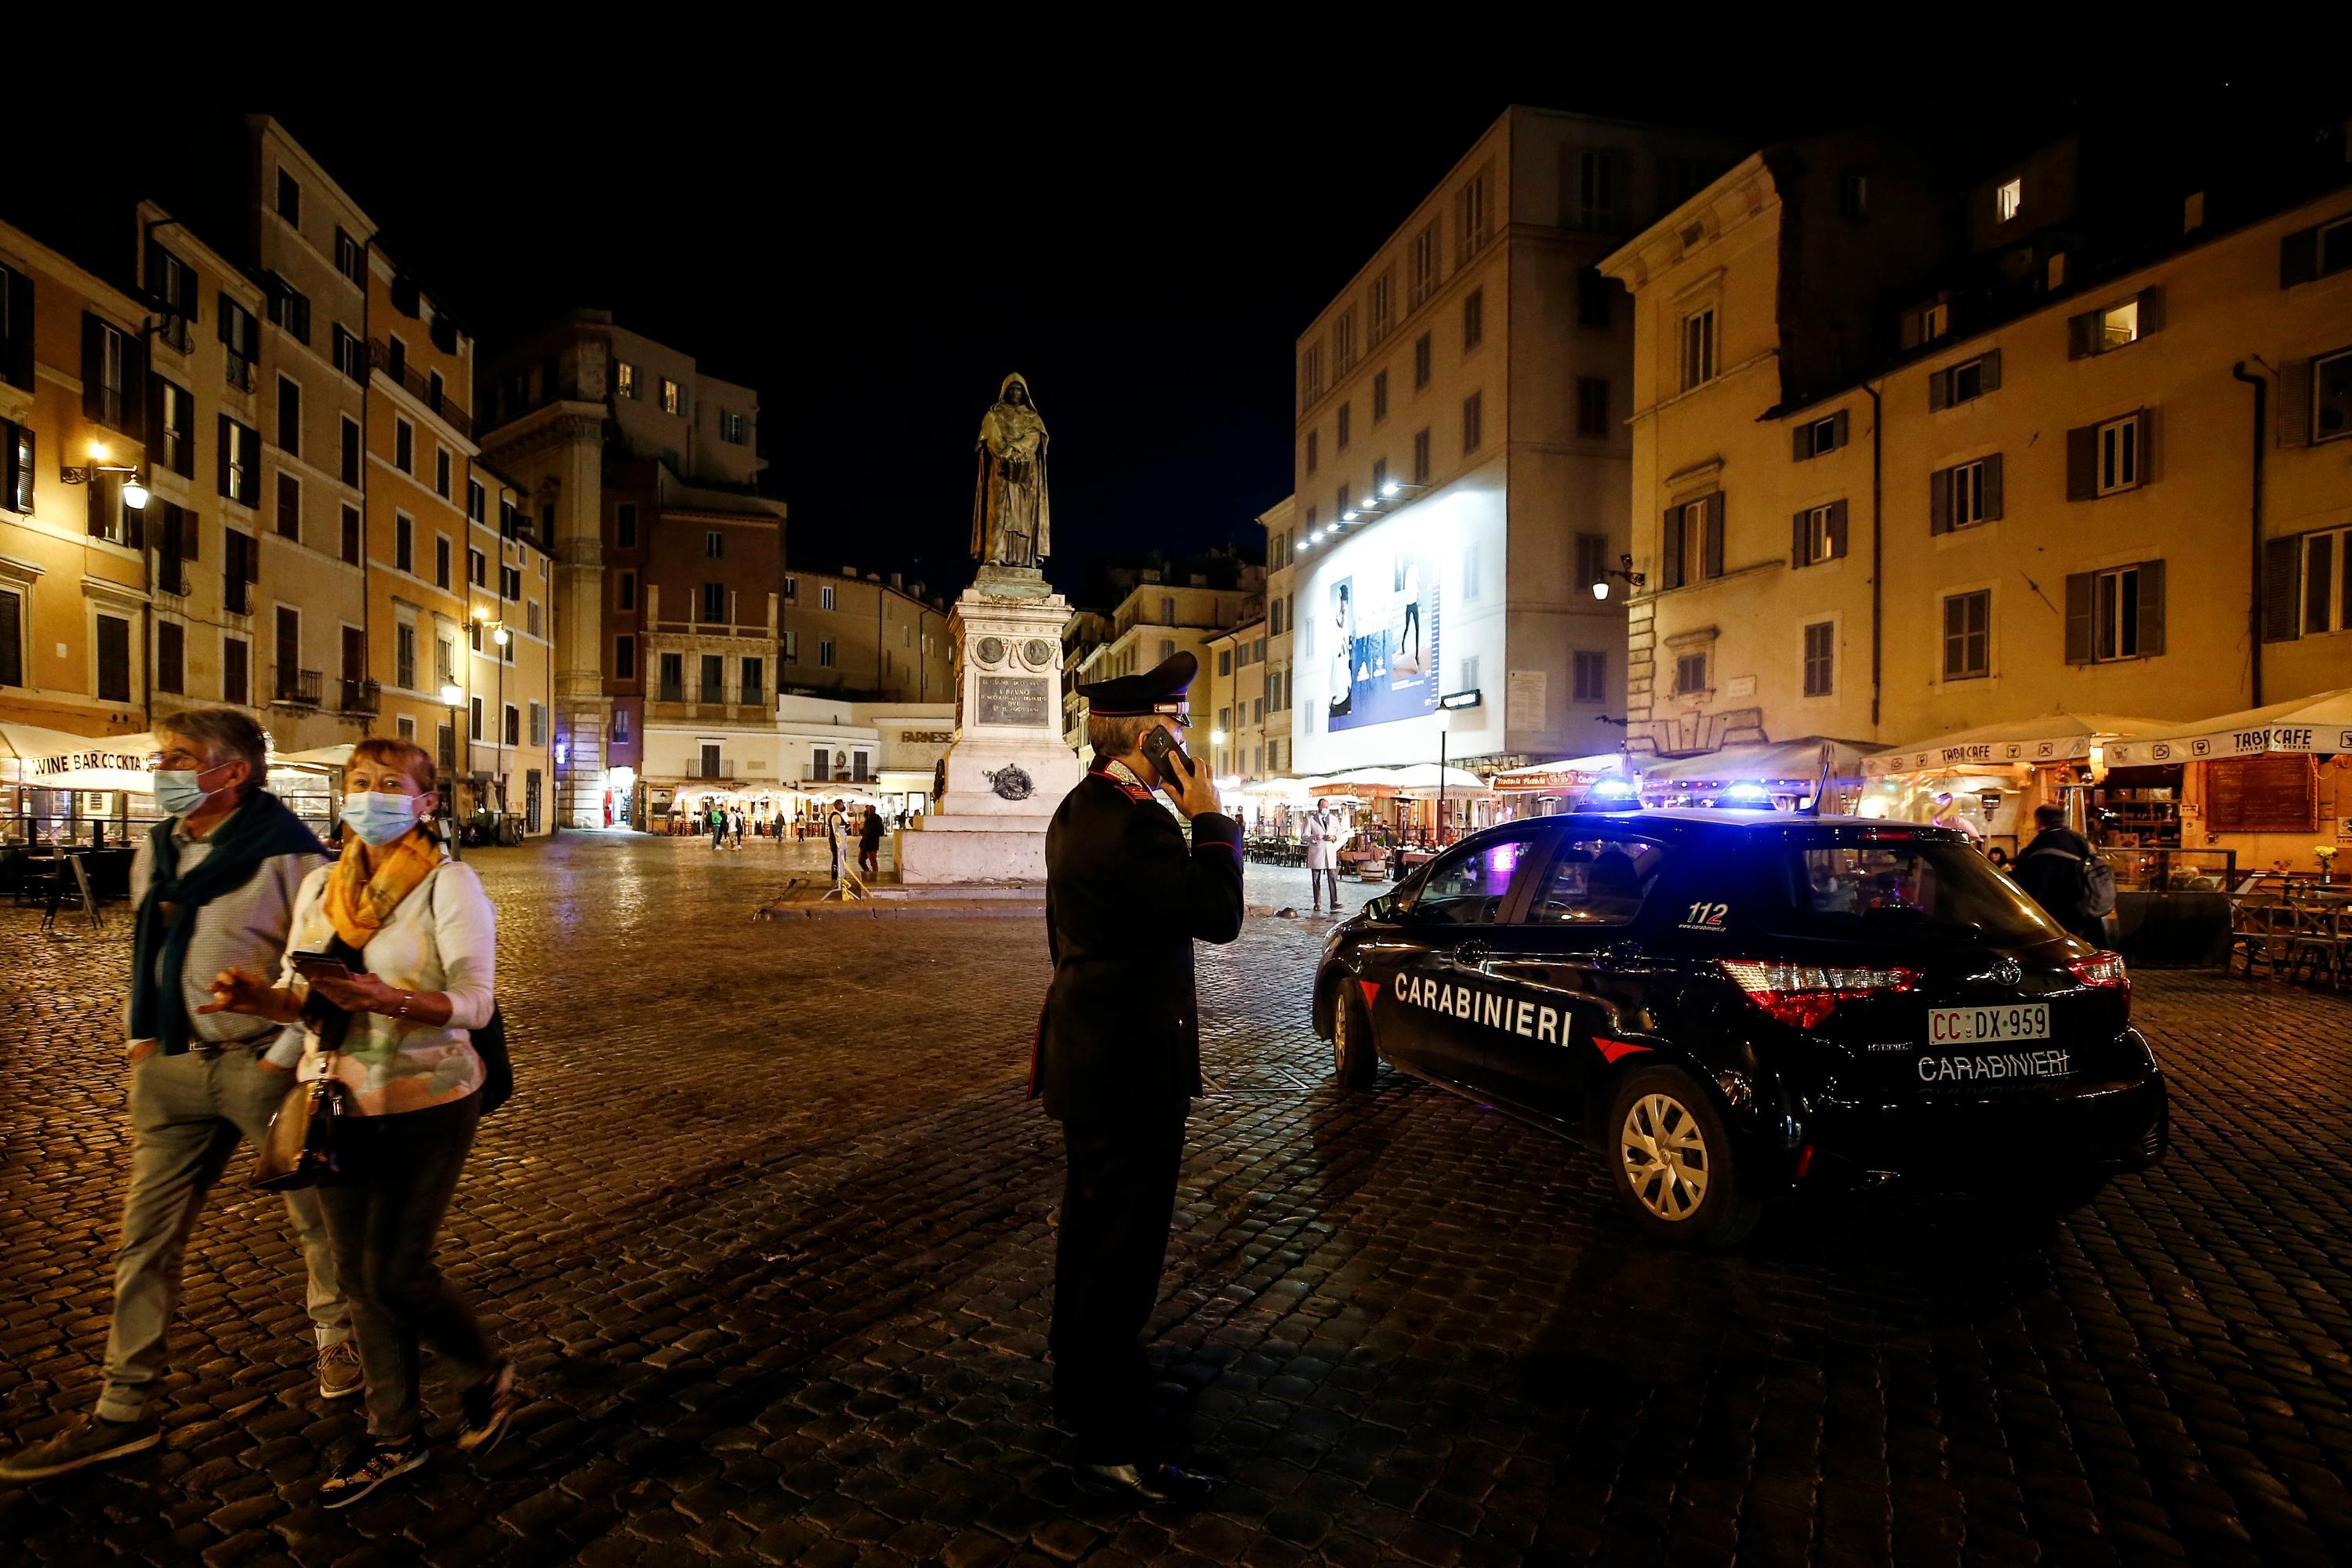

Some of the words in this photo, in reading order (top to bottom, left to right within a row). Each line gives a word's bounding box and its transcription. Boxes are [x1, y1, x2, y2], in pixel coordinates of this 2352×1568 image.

[902, 731, 953, 743] FARNESE
[2274, 729, 2312, 745] CAFE
[1966, 746, 1991, 758] CAFE
[32, 756, 69, 775] WINE
[74, 753, 99, 770] BAR
[1687, 902, 1729, 925] 112
[1395, 972, 1572, 1047] CARABINIERI
[1933, 1012, 1961, 1040] CC
[1975, 1010, 2001, 1039] DX
[2009, 1007, 2046, 1036] 959
[1918, 1049, 2068, 1081] CARABINIERI
